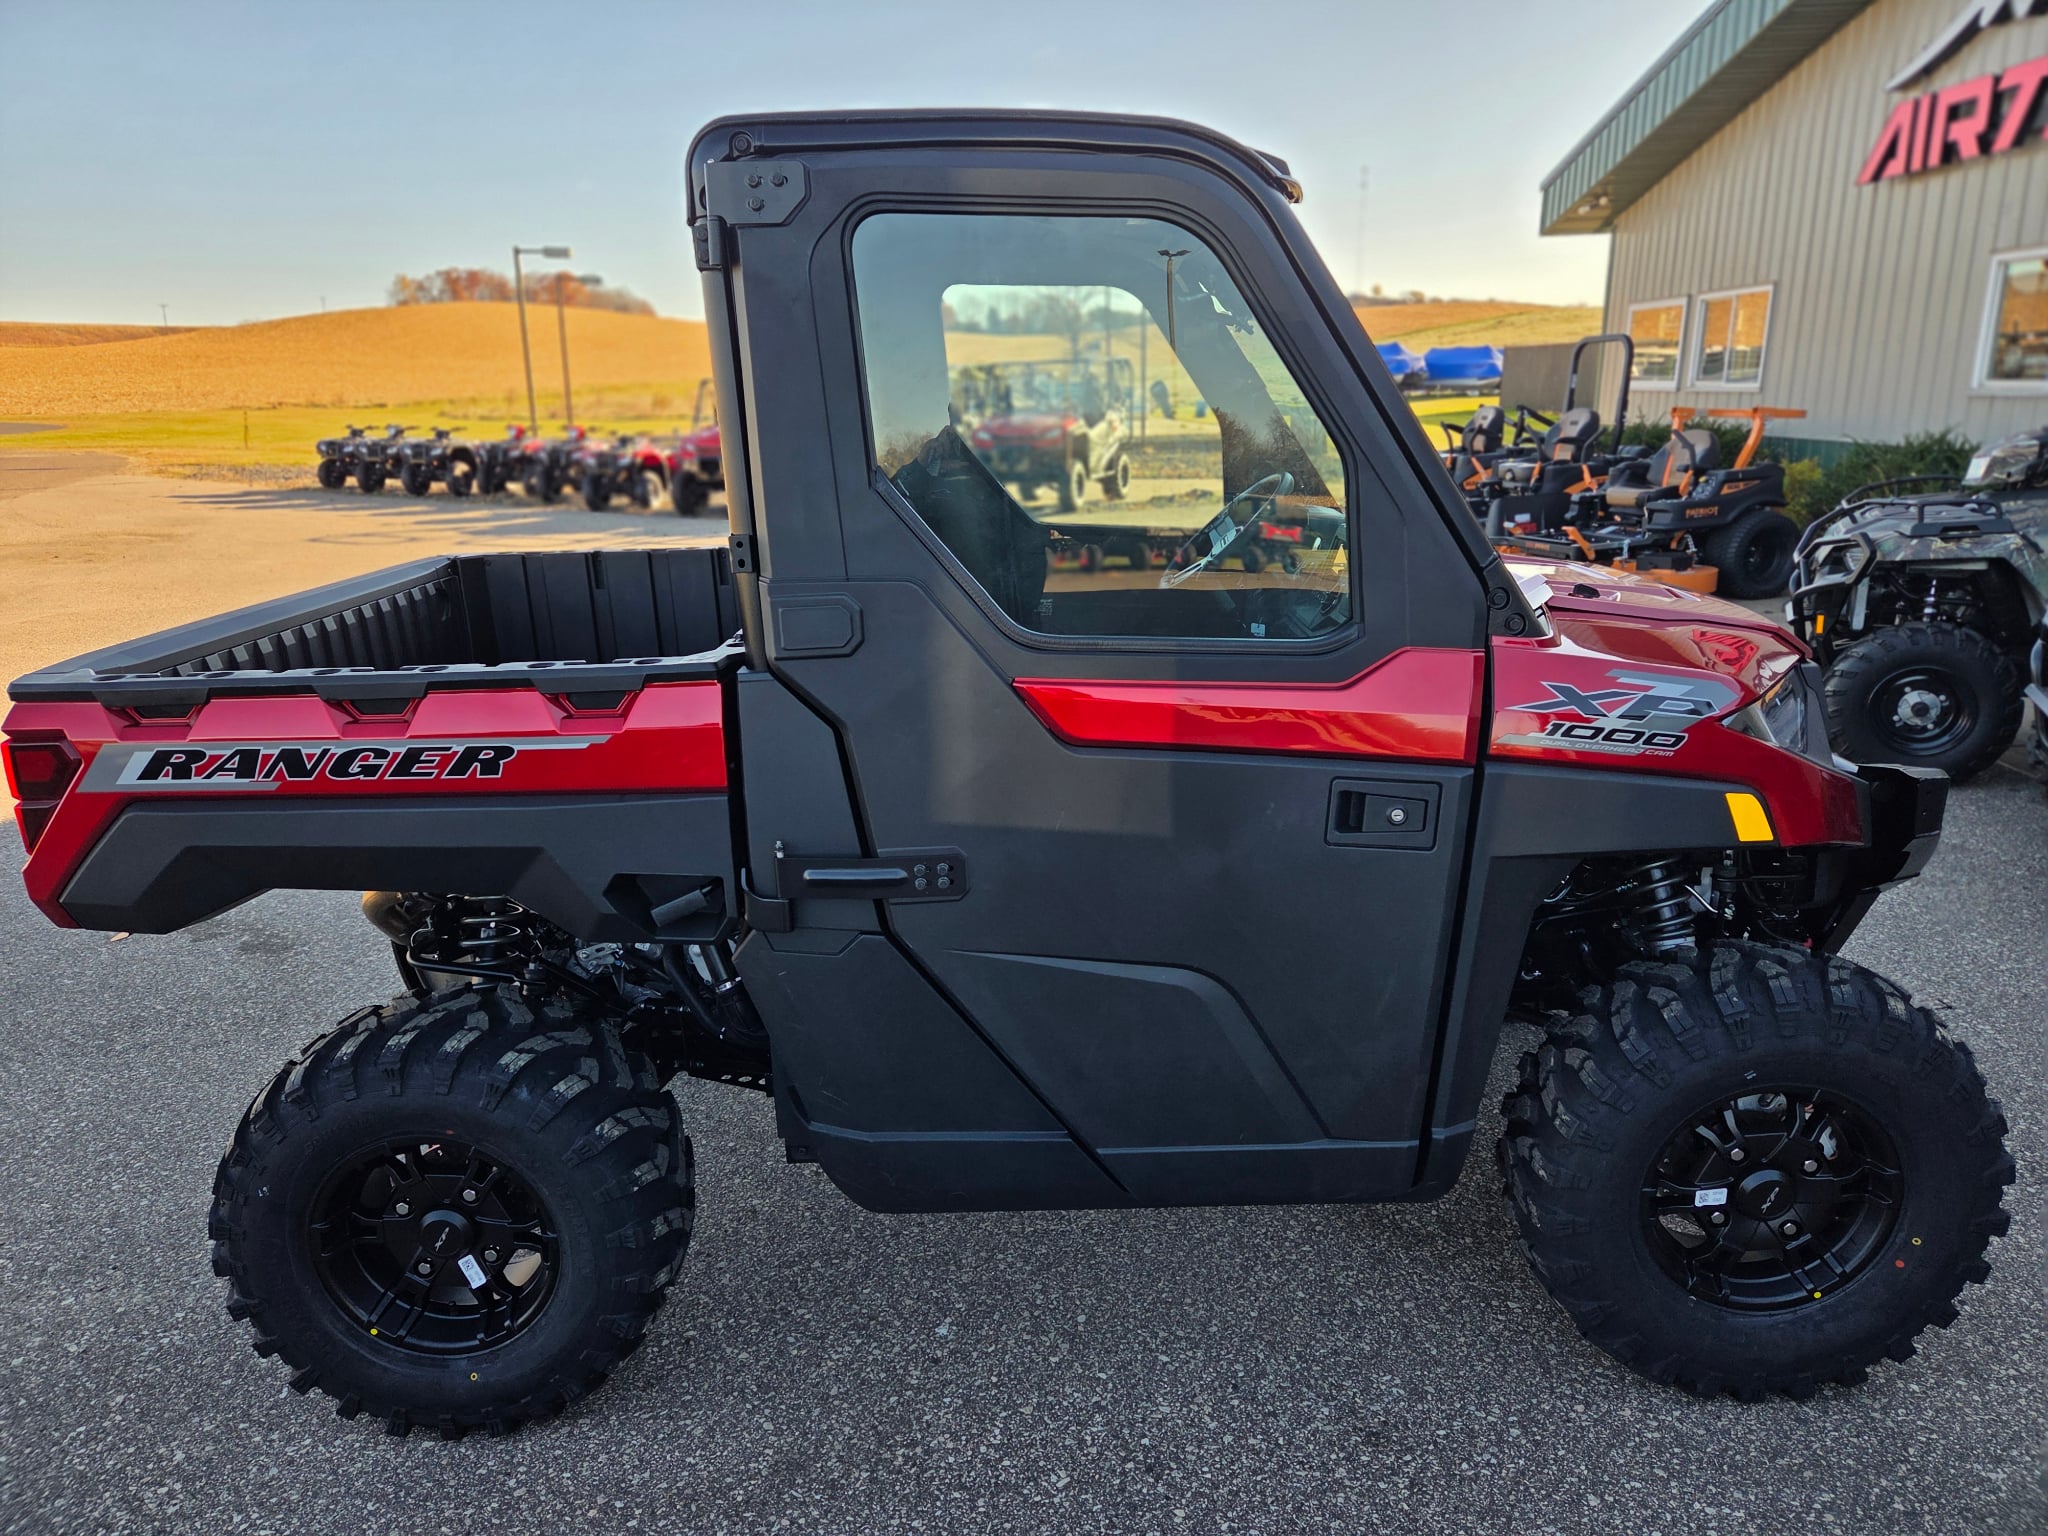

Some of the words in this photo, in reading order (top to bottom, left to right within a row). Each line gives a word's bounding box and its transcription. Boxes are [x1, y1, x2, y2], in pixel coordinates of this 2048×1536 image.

[1855, 54, 2048, 187] AIRT
[1504, 680, 1720, 724] XP
[1540, 739, 1572, 748] DUAL
[1575, 743, 1644, 754] OVERHEAD
[1645, 748, 1675, 758] CAM
[1544, 720, 1689, 750] 1000
[135, 745, 518, 782] RANGER
